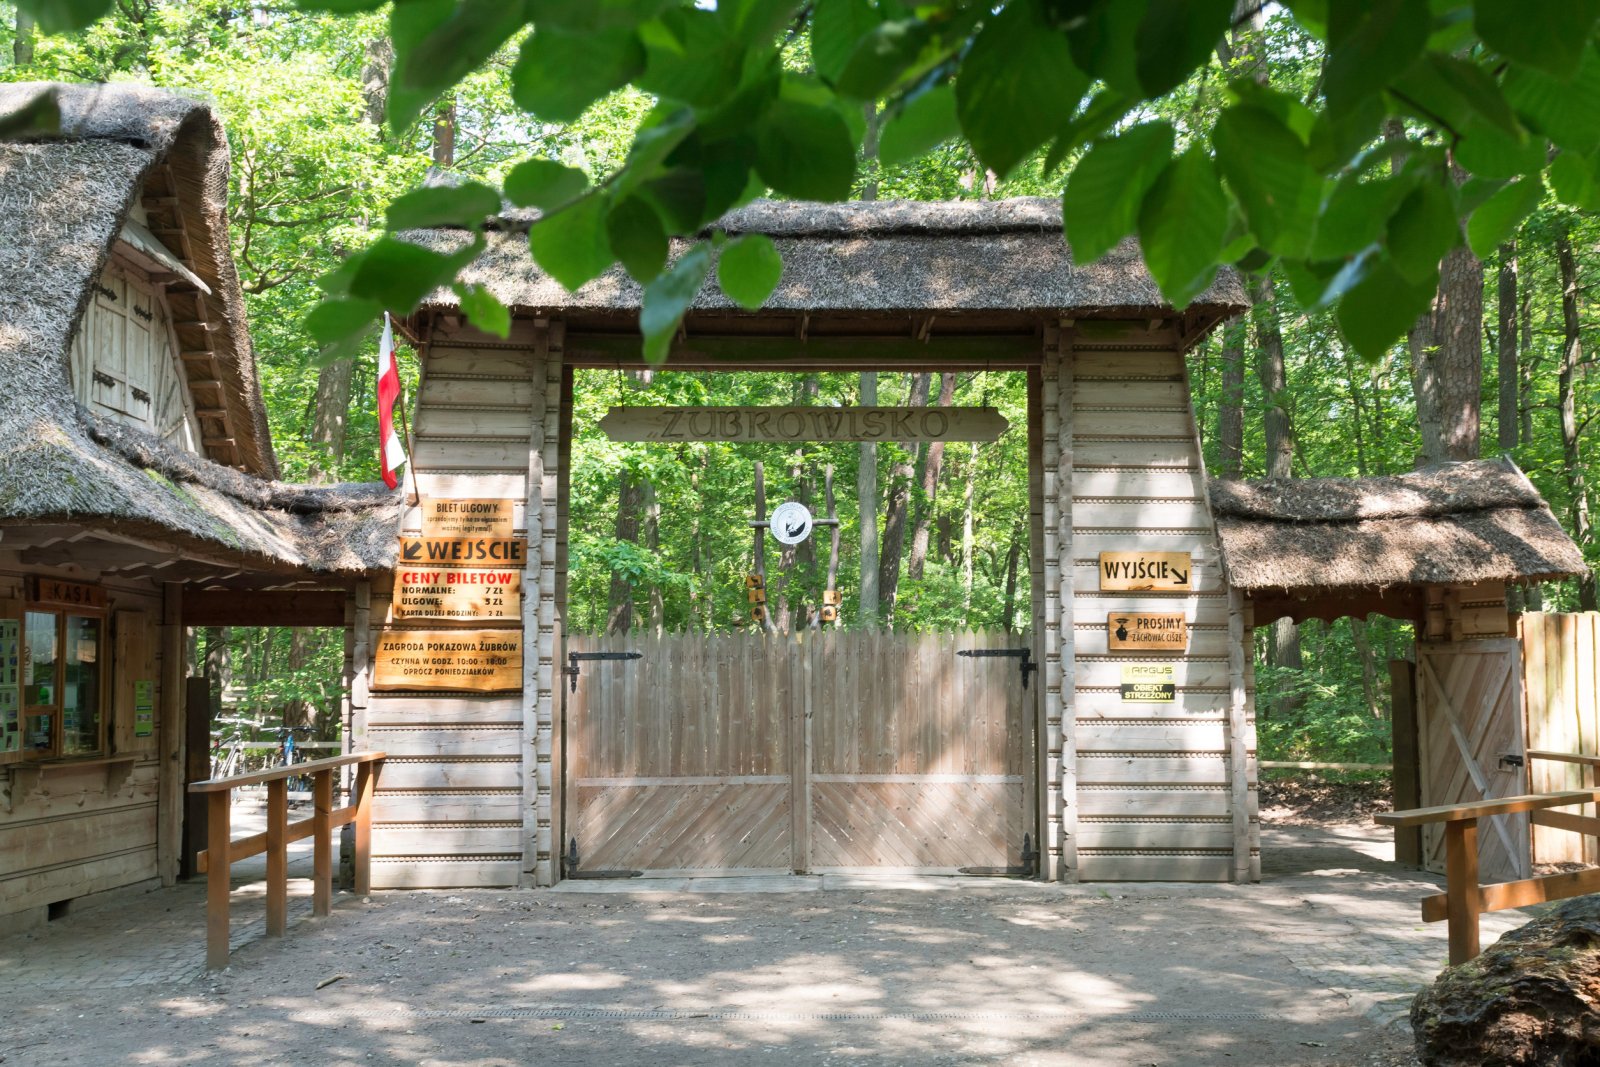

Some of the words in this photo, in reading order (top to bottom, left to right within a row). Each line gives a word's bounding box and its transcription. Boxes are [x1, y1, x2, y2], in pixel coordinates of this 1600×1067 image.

[436, 503, 458, 513] BILET
[460, 503, 499, 513] ULGOWY
[426, 539, 521, 560] WEJŚCIE
[1104, 557, 1168, 579] WYJŚCIE
[402, 572, 441, 584] CENY
[446, 570, 512, 584] BILETÓW
[54, 582, 92, 602] KASA
[401, 586, 456, 594] NORMALNE:
[401, 597, 443, 606] ULGOWE:
[492, 598, 503, 606] ZŁ
[425, 609, 445, 617] DUŻEJ
[1137, 617, 1181, 629] PROSIMY
[383, 642, 424, 651] ZAGRODA
[427, 642, 477, 652] POKAZOWA
[479, 640, 518, 652] ŻUBRÓW
[391, 657, 420, 665] CZYNNA
[485, 657, 507, 665] 18:00
[403, 667, 433, 675] OPRÓCZ
[434, 667, 495, 675] PONIEDZIAŁKÓW
[1131, 666, 1173, 674] ARGUS
[1133, 684, 1164, 692] OBIEKT
[1124, 691, 1173, 699] STRZEŻONY
